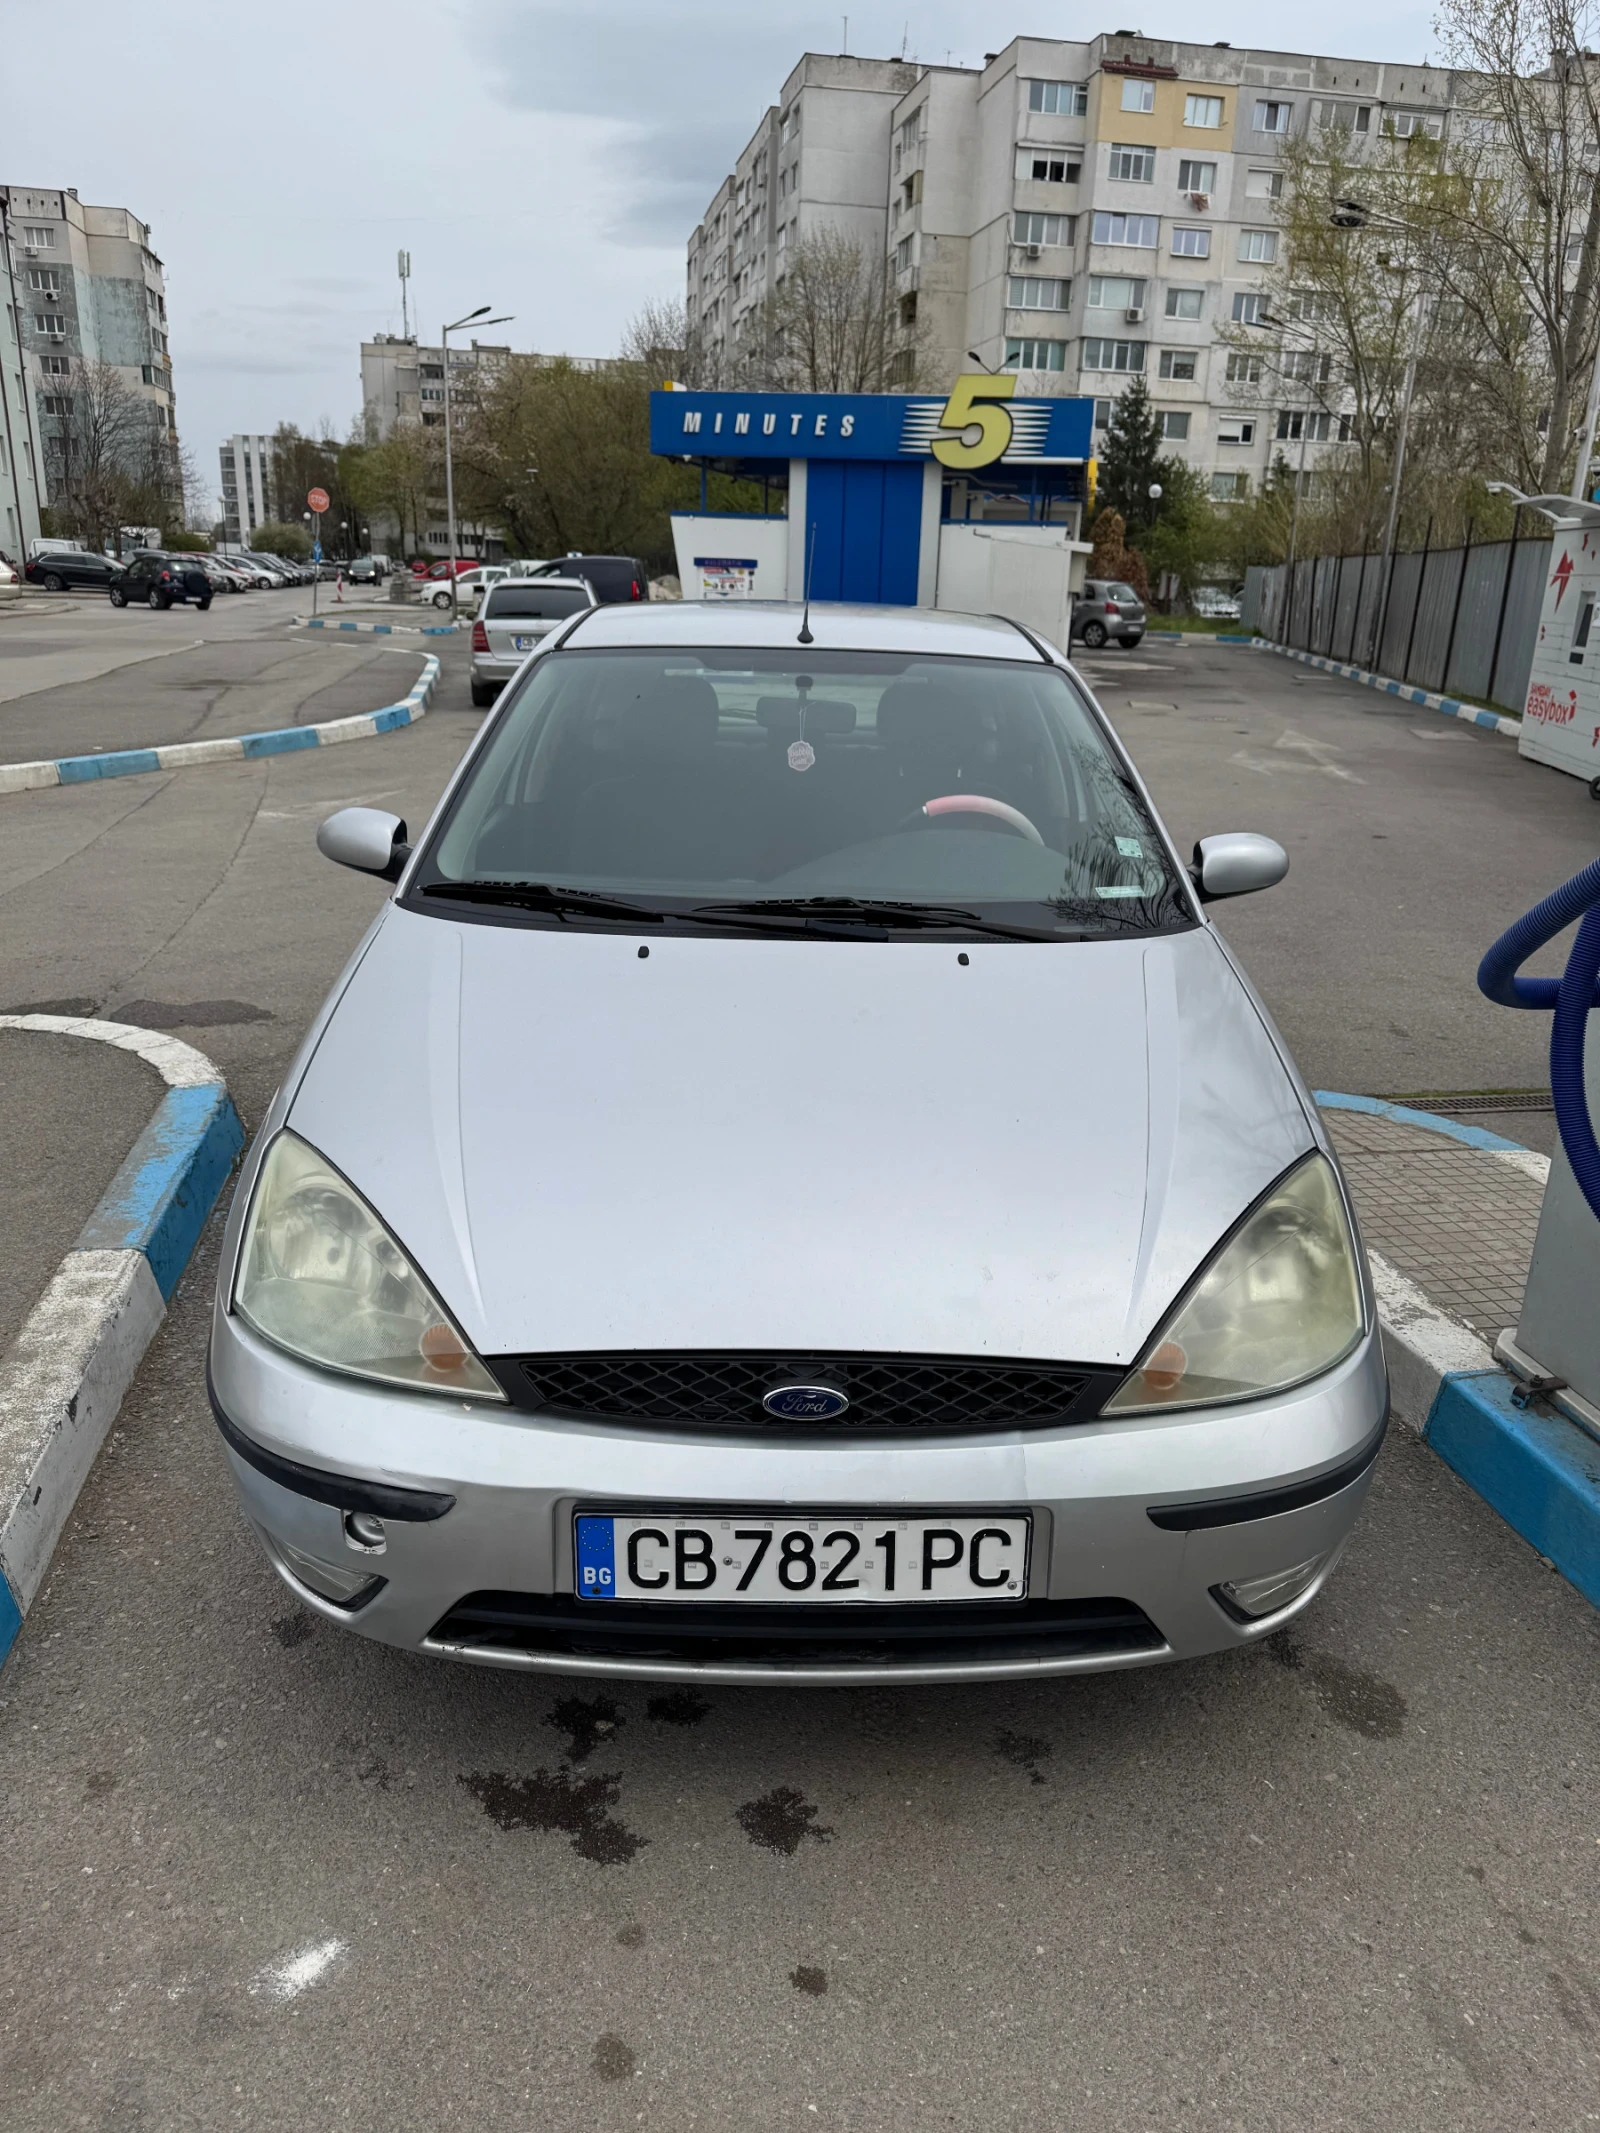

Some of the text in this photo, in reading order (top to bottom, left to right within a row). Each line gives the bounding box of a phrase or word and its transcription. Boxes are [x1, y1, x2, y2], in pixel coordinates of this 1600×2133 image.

[683, 374, 1018, 469] MINUTES 5
[1527, 695, 1568, 725] easybox
[781, 1393, 828, 1413] Ford
[583, 1528, 1012, 1592] BG CB 7821 PC
